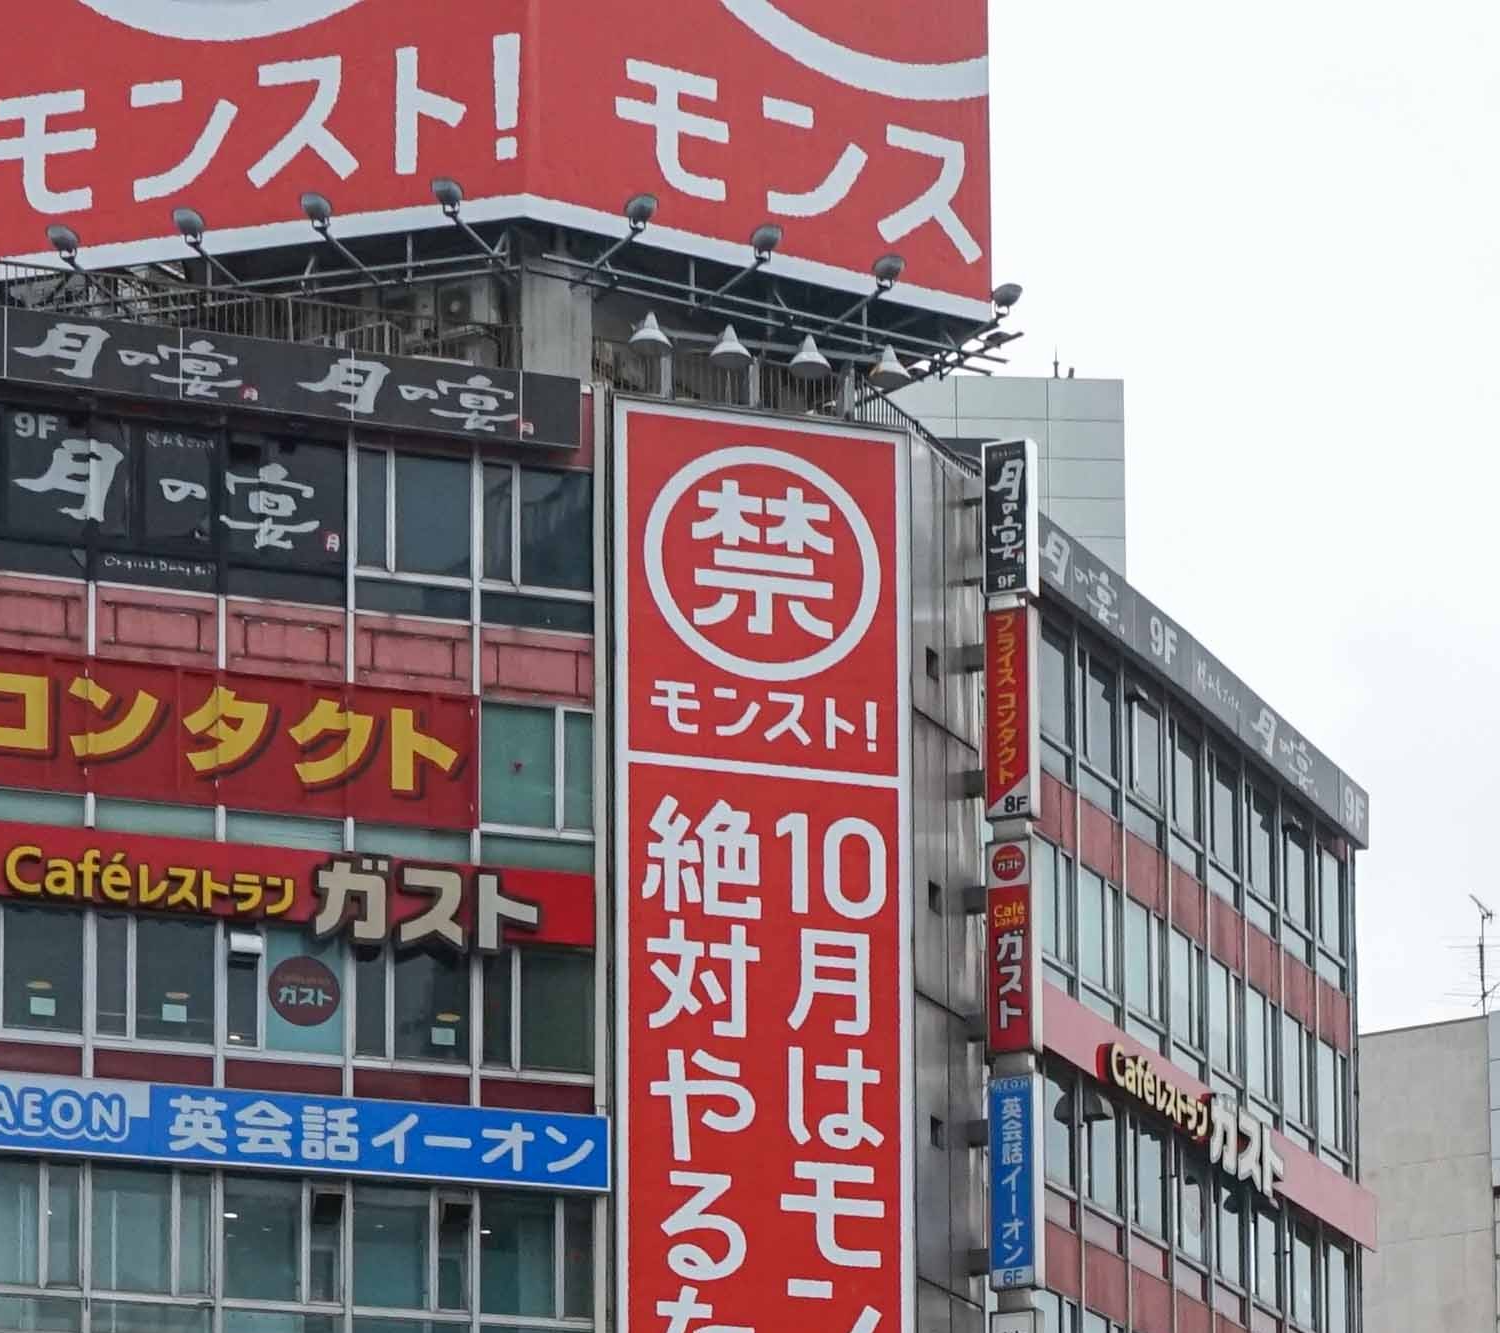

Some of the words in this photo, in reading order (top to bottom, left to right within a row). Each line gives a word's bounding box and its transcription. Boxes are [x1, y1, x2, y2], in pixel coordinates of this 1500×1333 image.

[615, 58, 982, 264] モンス
[14, 322, 241, 399] 月の宴
[298, 357, 520, 433] 月の宴
[14, 414, 58, 440] 9F
[14, 438, 319, 550] 月の宴
[989, 458, 1026, 563] 月の宴
[692, 479, 834, 640] 禁
[997, 573, 1016, 589] 9F
[994, 614, 1016, 687] プライス
[1150, 615, 1178, 664] 9F
[651, 680, 877, 752] モンスト!
[996, 690, 1015, 785] コンタクト
[1003, 796, 1028, 813] 8F
[314, 857, 539, 950] ガスト
[277, 984, 334, 1008] ガスト
[997, 929, 1024, 1029] ガスト
[167, 1094, 595, 1175] 英会話イーオン
[1208, 1100, 1284, 1198] ガスト
[1002, 1097, 1025, 1265] 英会話イーオン
[1002, 1270, 1023, 1285] 6F
